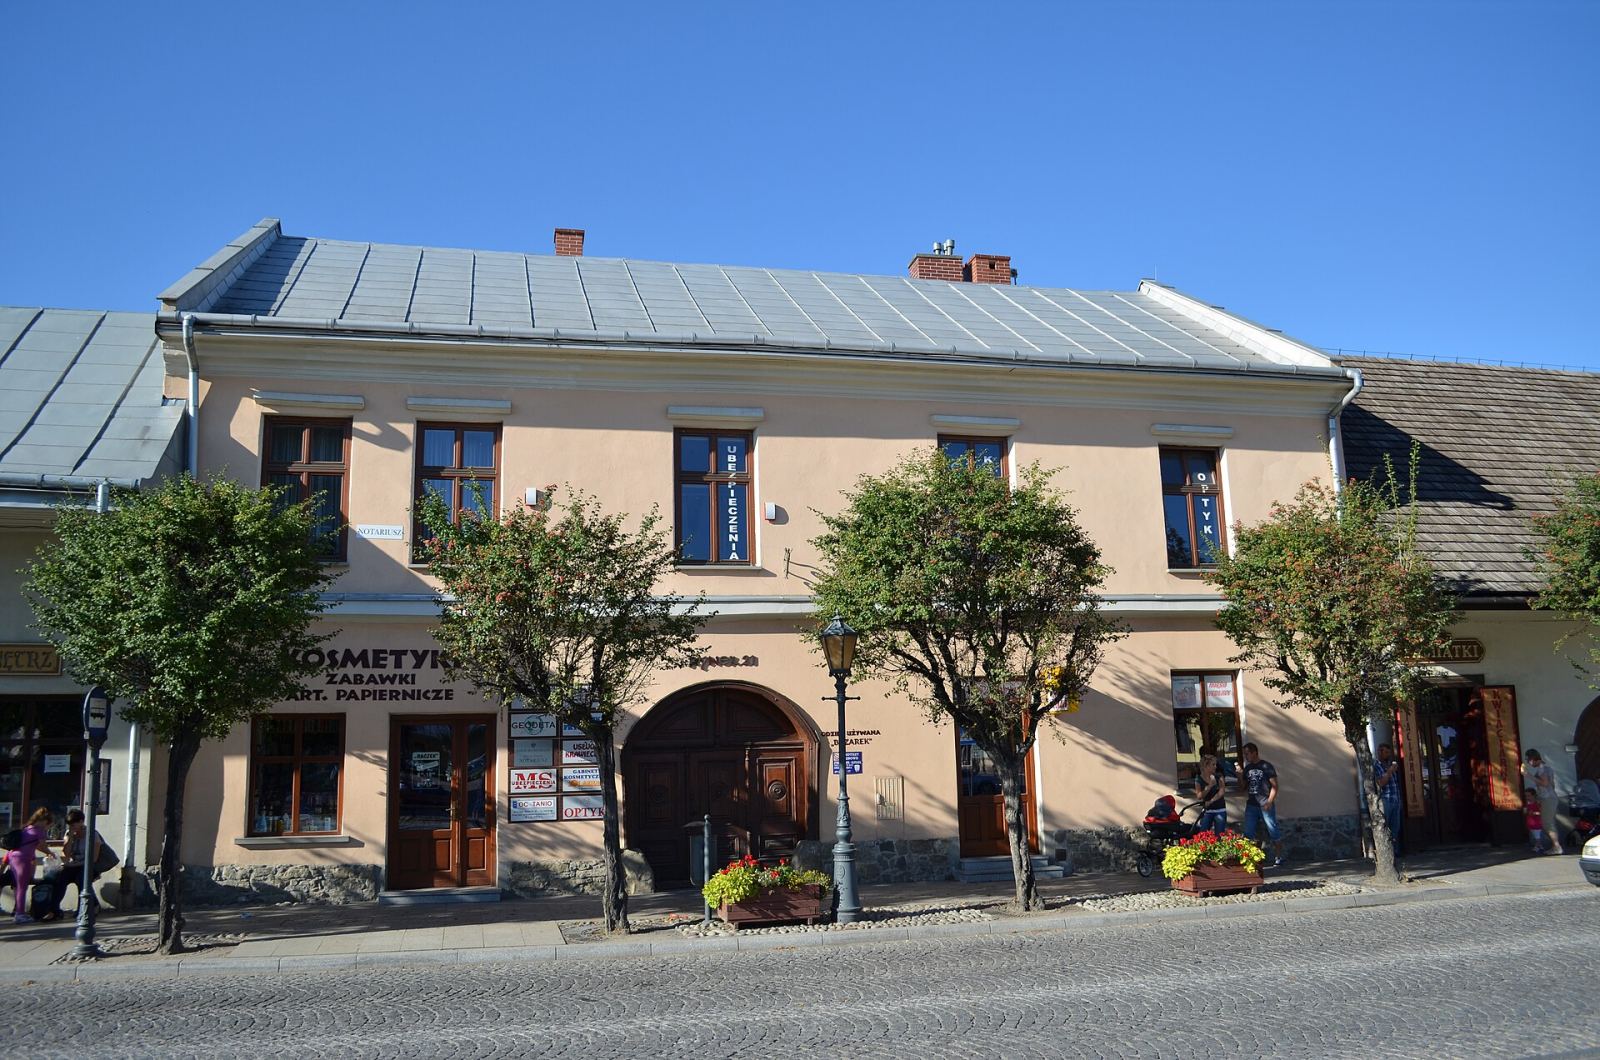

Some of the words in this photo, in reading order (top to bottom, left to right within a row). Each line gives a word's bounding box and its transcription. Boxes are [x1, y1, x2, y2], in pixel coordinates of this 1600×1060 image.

[727, 445, 739, 560] UBEZPIECZENIA
[1197, 472, 1213, 534] OPTYK
[358, 527, 402, 536] NOTARIUSZ
[326, 673, 416, 685] ZABAWKI
[336, 689, 454, 701] PAPIERNICZE
[511, 721, 556, 729] GEODETA
[846, 728, 881, 736] UŻYWANA
[831, 738, 873, 747] „BZAREK”
[514, 771, 553, 790] MS
[564, 807, 605, 818] OPTYK
